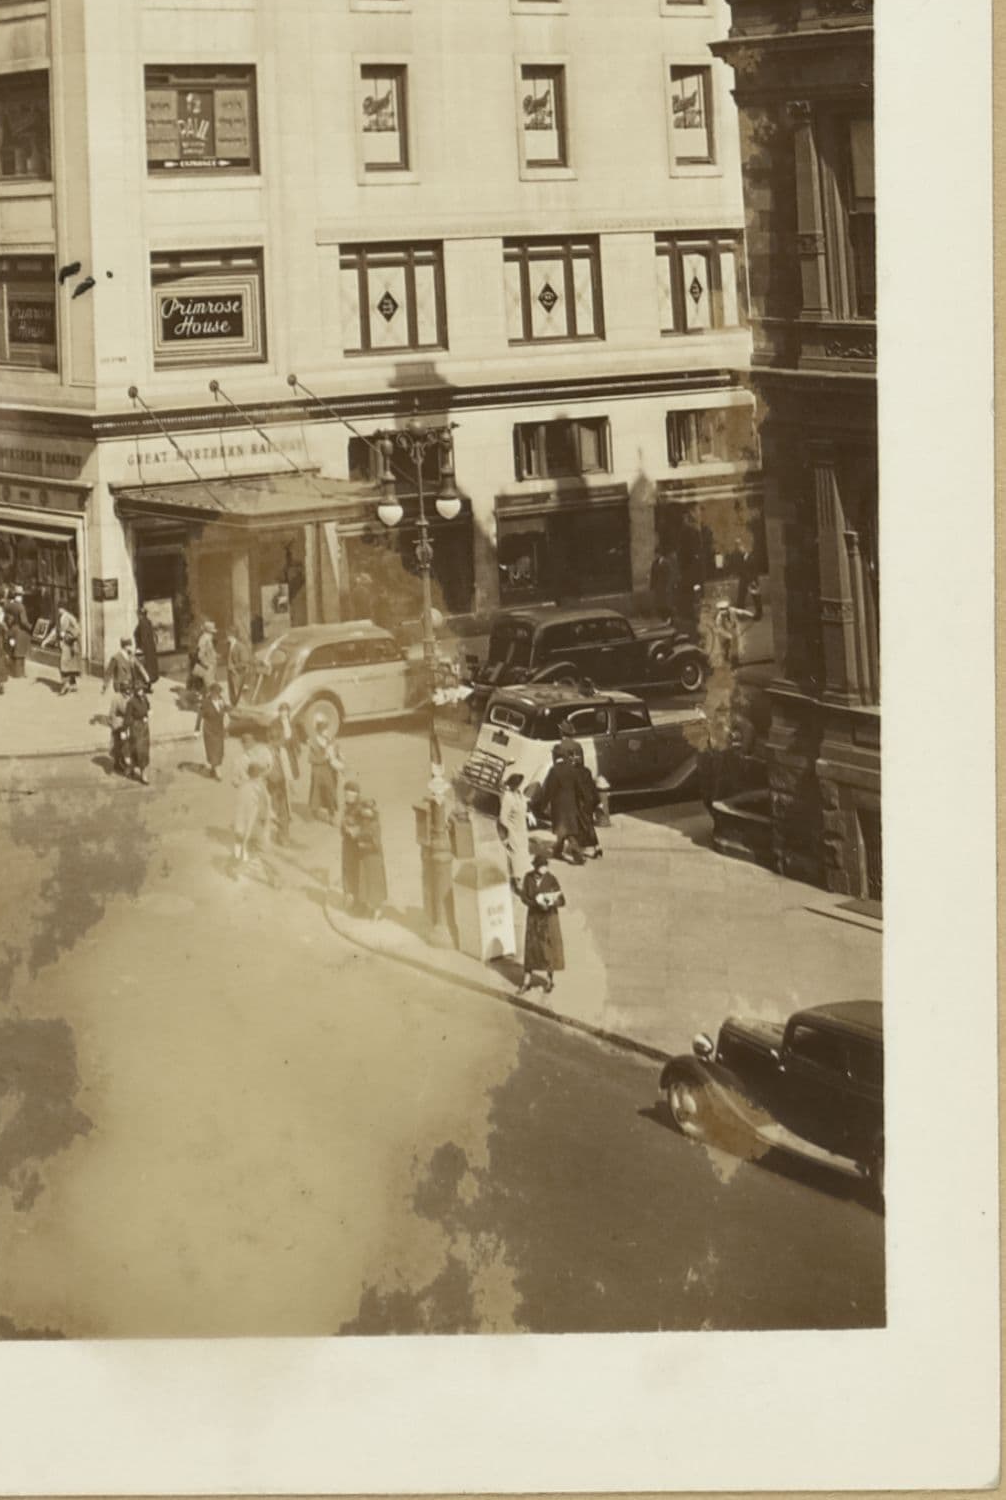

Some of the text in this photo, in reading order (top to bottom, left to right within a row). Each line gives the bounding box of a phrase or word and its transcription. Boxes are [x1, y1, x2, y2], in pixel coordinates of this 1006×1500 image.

[161, 297, 242, 319] Primrose
[174, 316, 231, 337] House
[127, 451, 167, 466] GREAT
